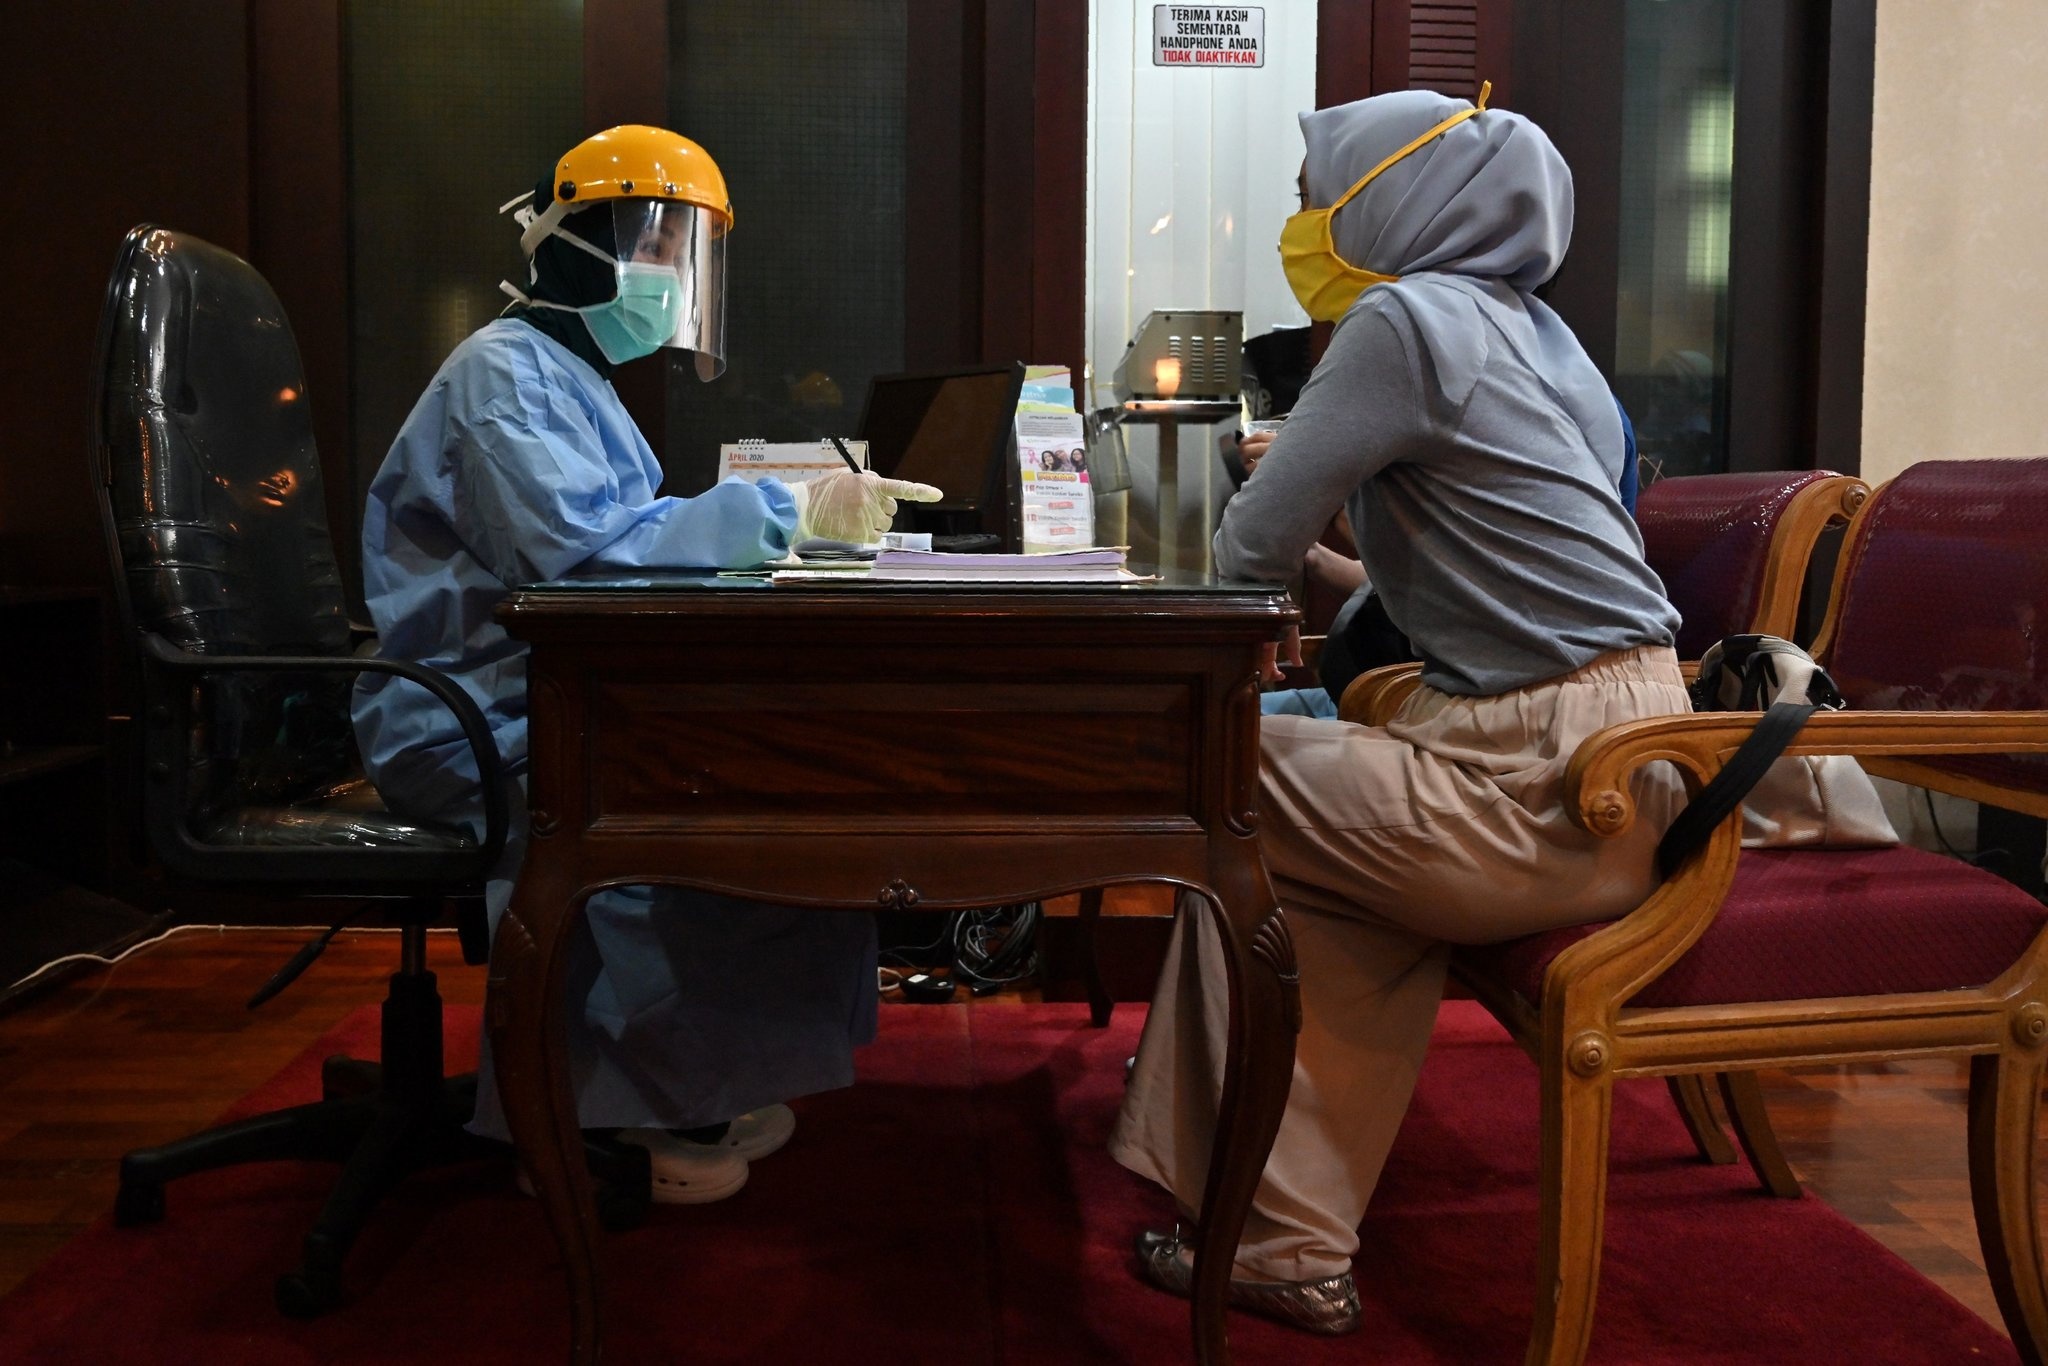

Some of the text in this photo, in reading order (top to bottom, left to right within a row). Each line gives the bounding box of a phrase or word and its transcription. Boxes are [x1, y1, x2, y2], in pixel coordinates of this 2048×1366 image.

[1171, 9, 1248, 22] TERIMA KASIH
[1177, 22, 1241, 35] SEMENTARA
[1160, 36, 1257, 50] HANDPHONE ANDA
[1162, 50, 1256, 63] TIDAK DIAKTIFKAN
[728, 453, 765, 462] APRIL 2020
